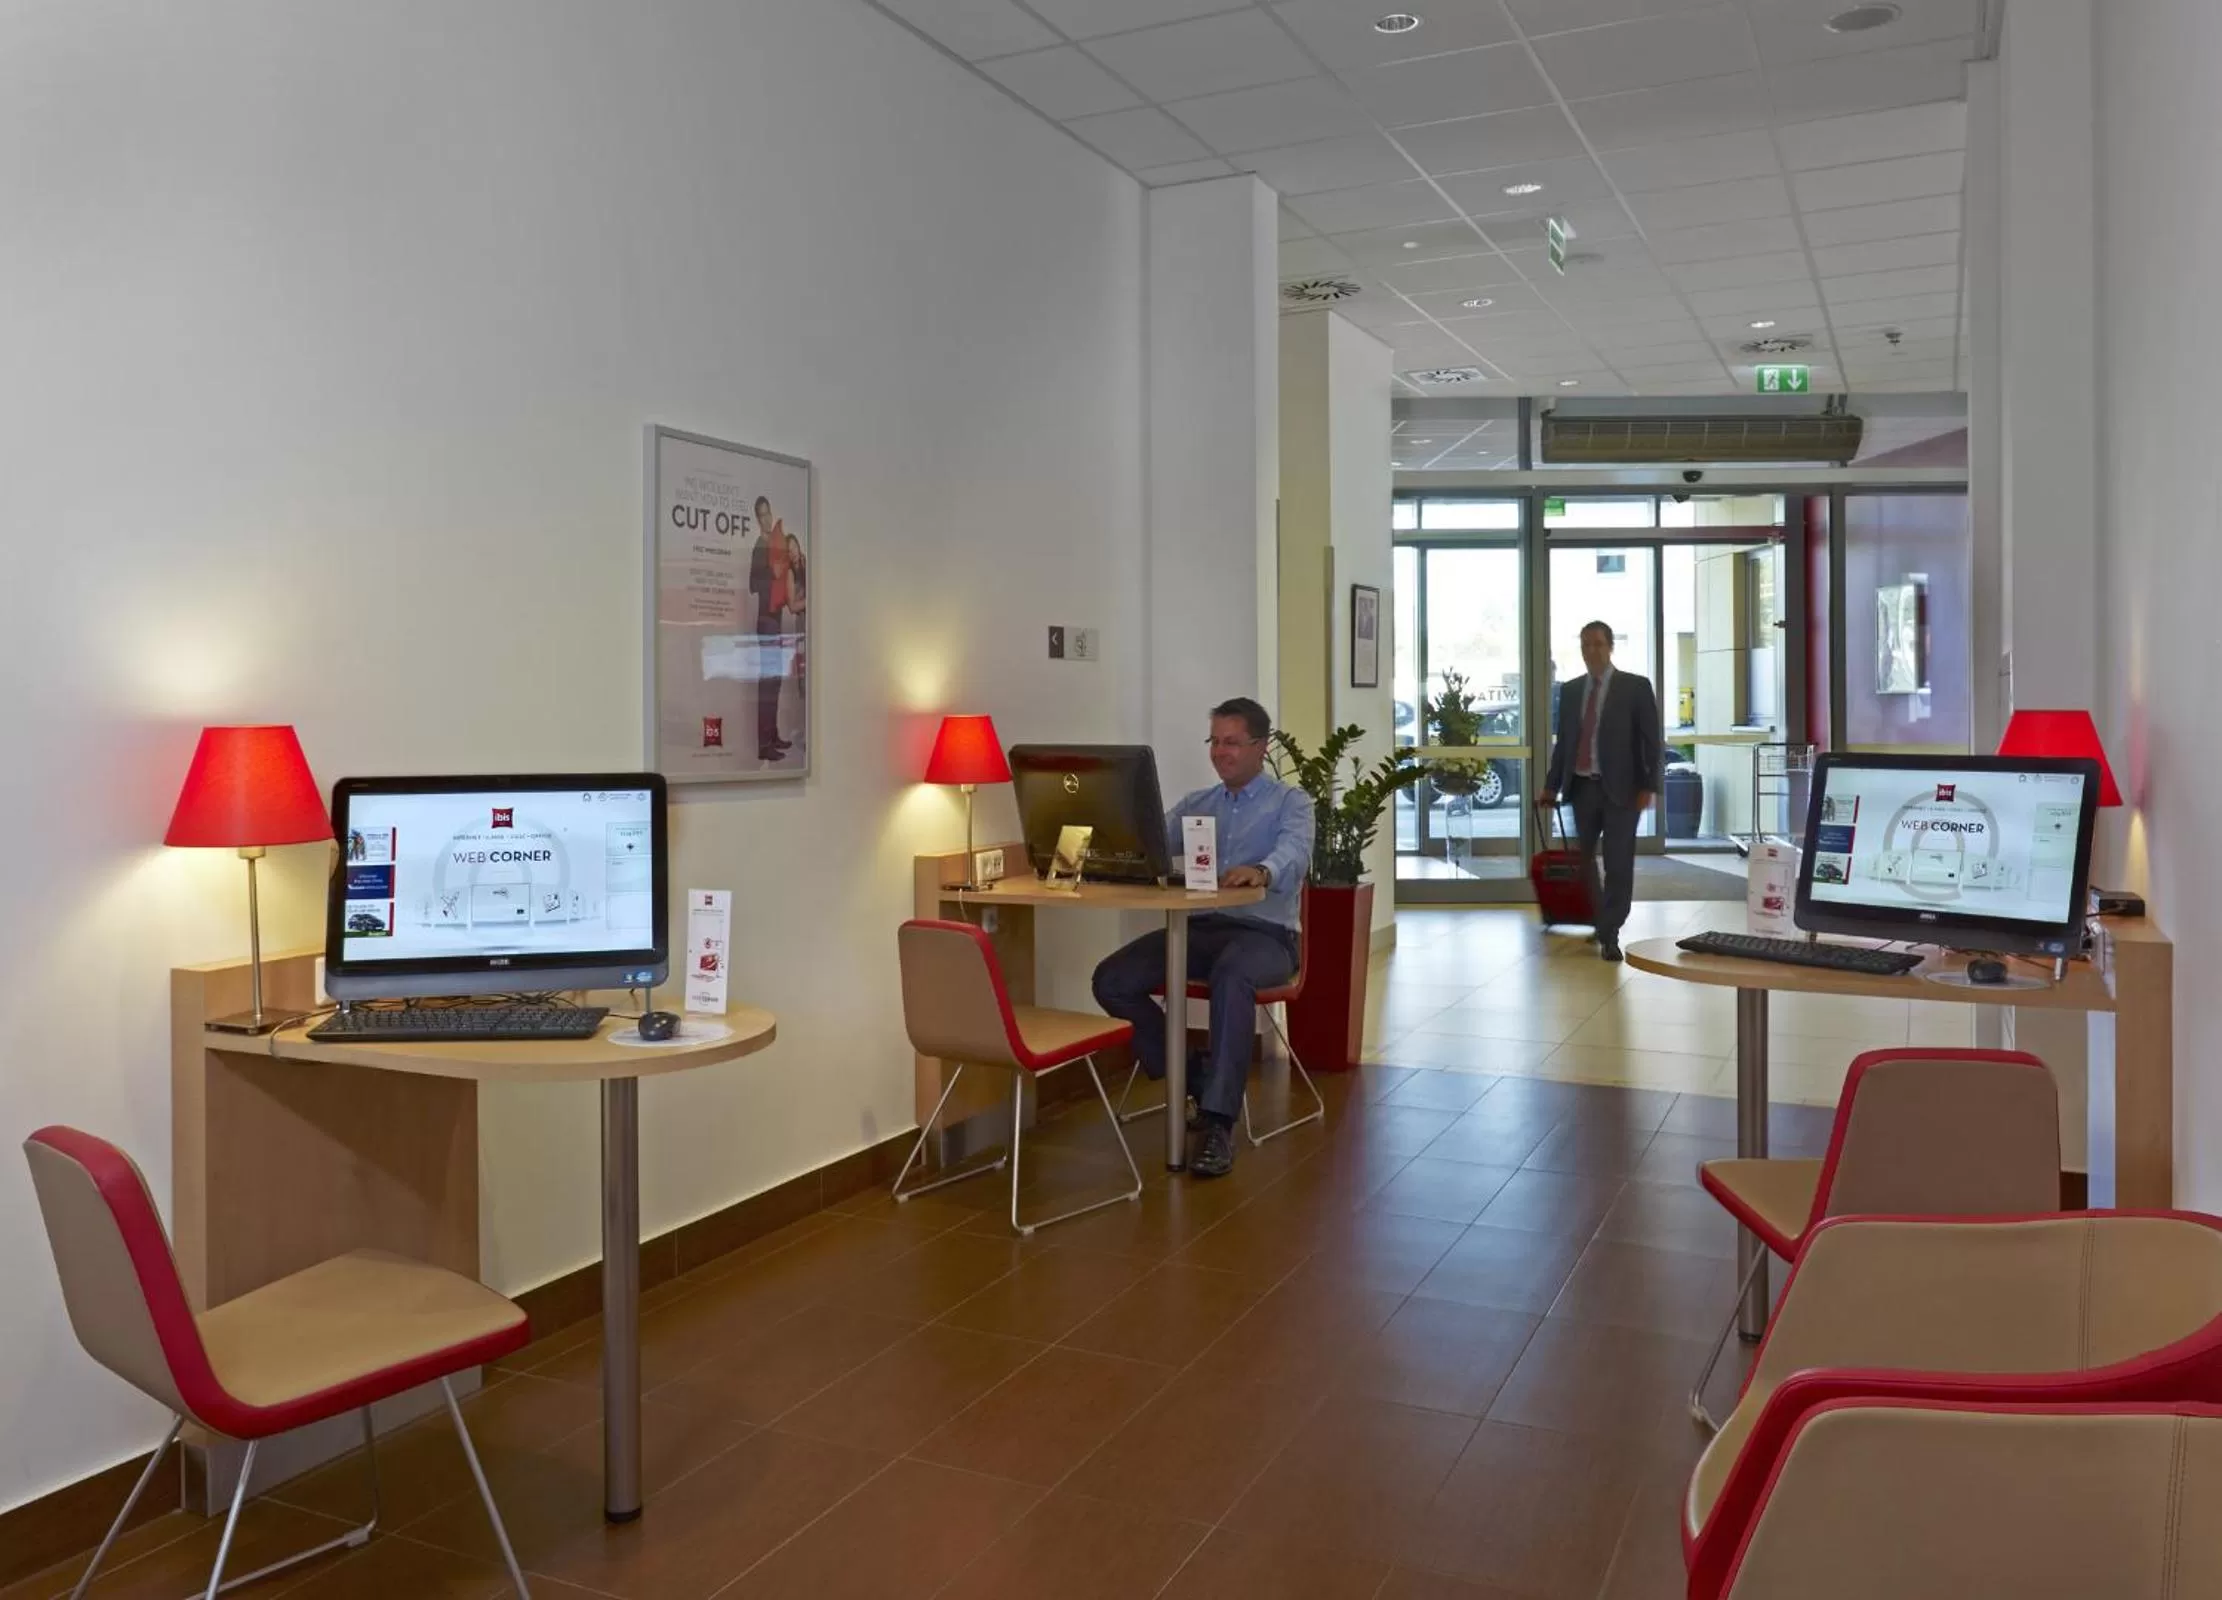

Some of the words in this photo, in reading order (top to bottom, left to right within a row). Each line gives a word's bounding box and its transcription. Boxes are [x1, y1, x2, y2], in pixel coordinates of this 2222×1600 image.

[672, 504, 711, 532] CUT
[715, 511, 751, 538] OFF
[494, 812, 511, 823] ibis
[1901, 820, 1929, 831] WEB
[1931, 821, 1985, 834] CORNER
[452, 851, 487, 864] WEB
[489, 849, 552, 863] CORNER
